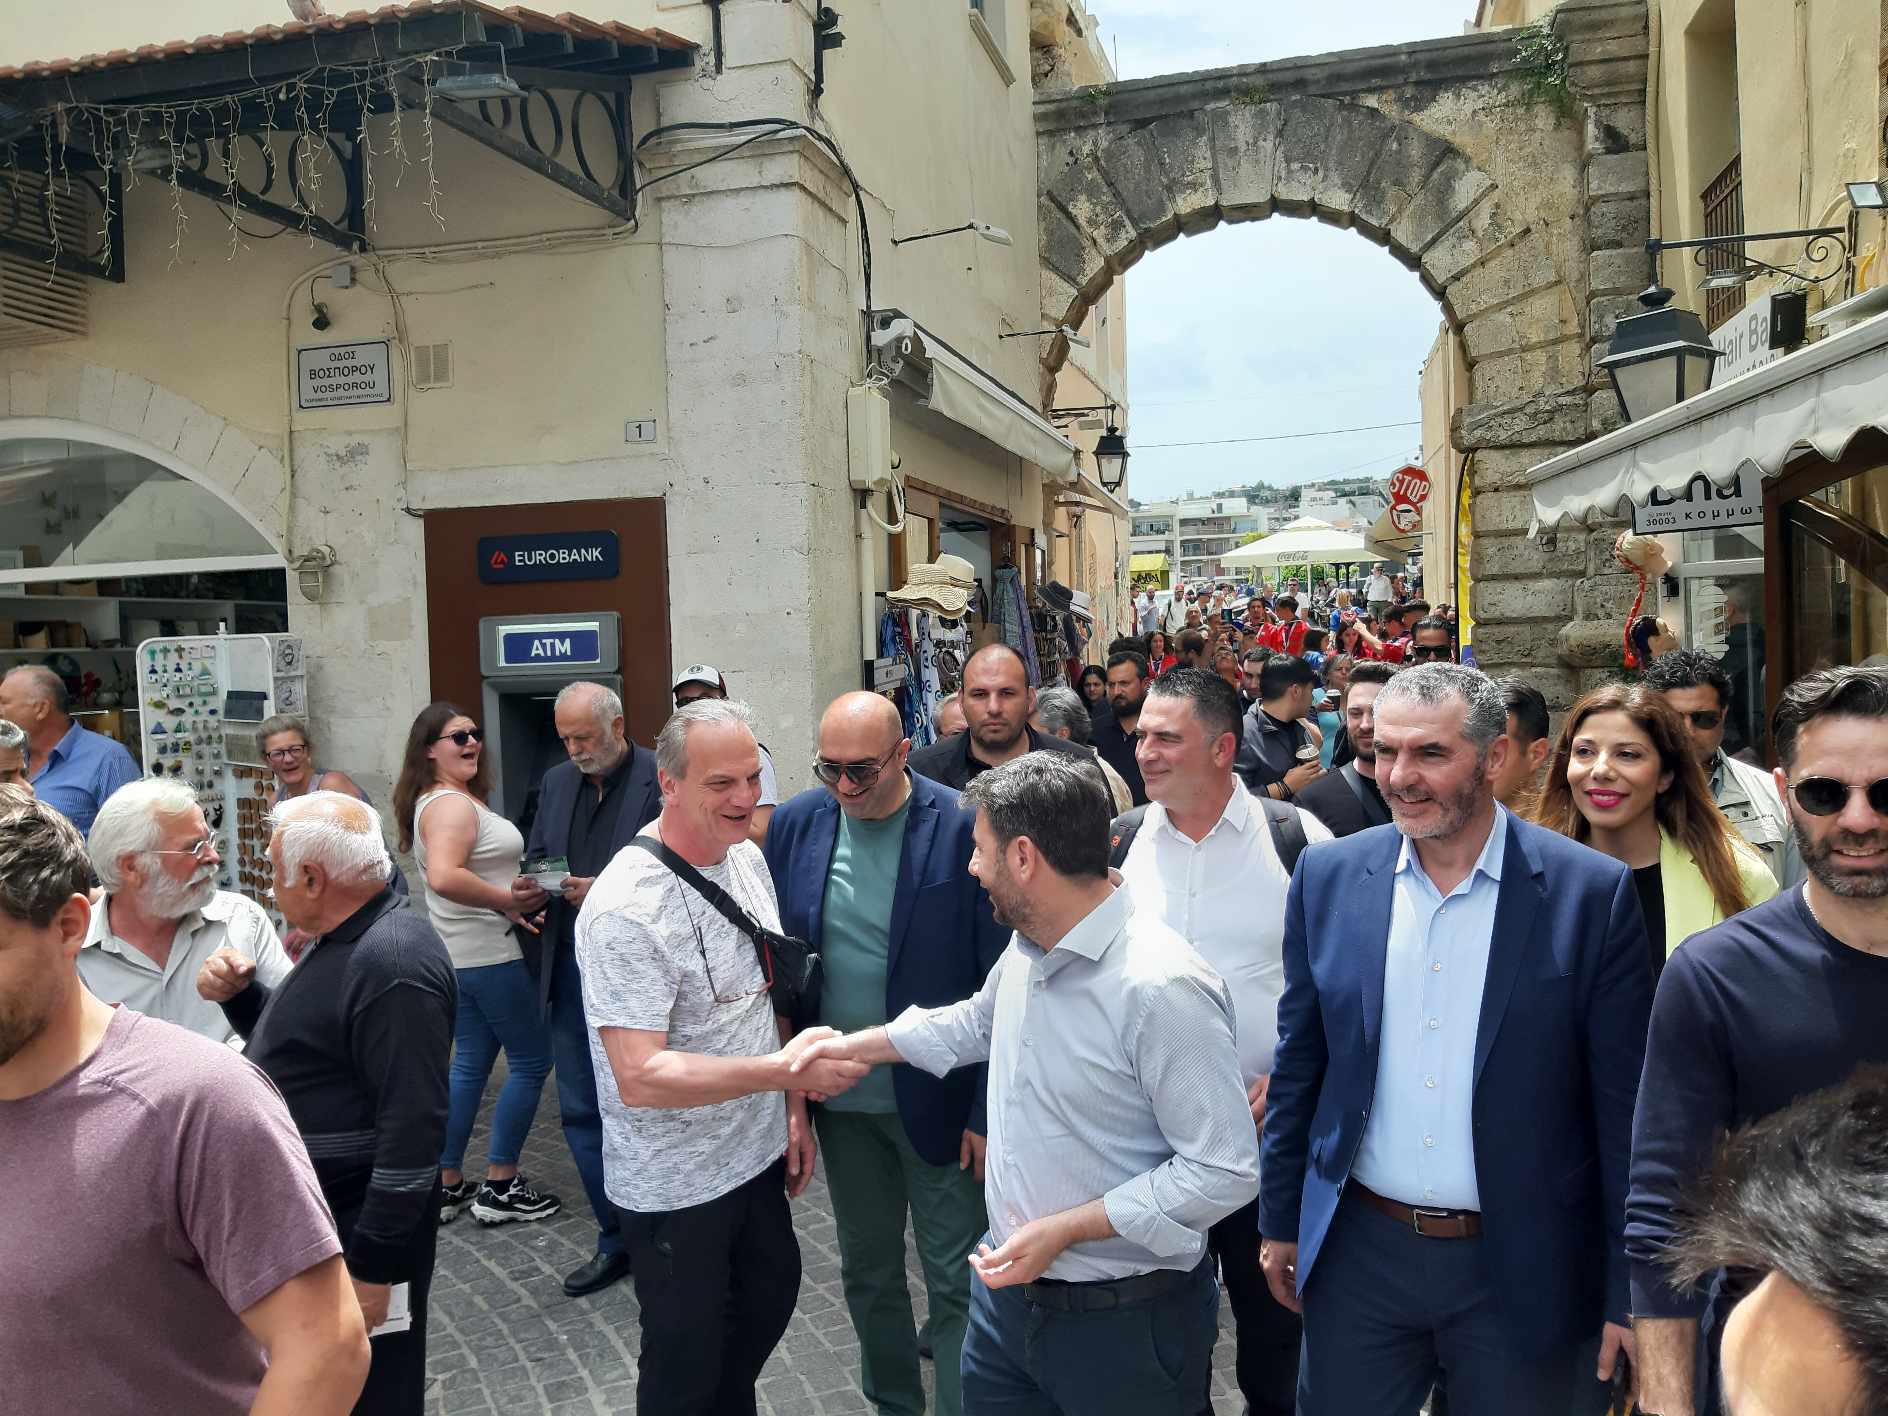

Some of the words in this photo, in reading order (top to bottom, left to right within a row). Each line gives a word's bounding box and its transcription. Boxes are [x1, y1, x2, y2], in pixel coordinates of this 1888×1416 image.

[329, 351, 357, 361] ΟΔΟΣ
[309, 364, 375, 380] ΒΟΣΠΟΡΟΥ
[312, 381, 376, 394] VOSPOROU
[635, 423, 642, 438] 1
[1389, 473, 1430, 503] STOP
[1646, 517, 1676, 526] 30003
[515, 547, 603, 565] EUROBANK
[531, 638, 571, 657] ATM
